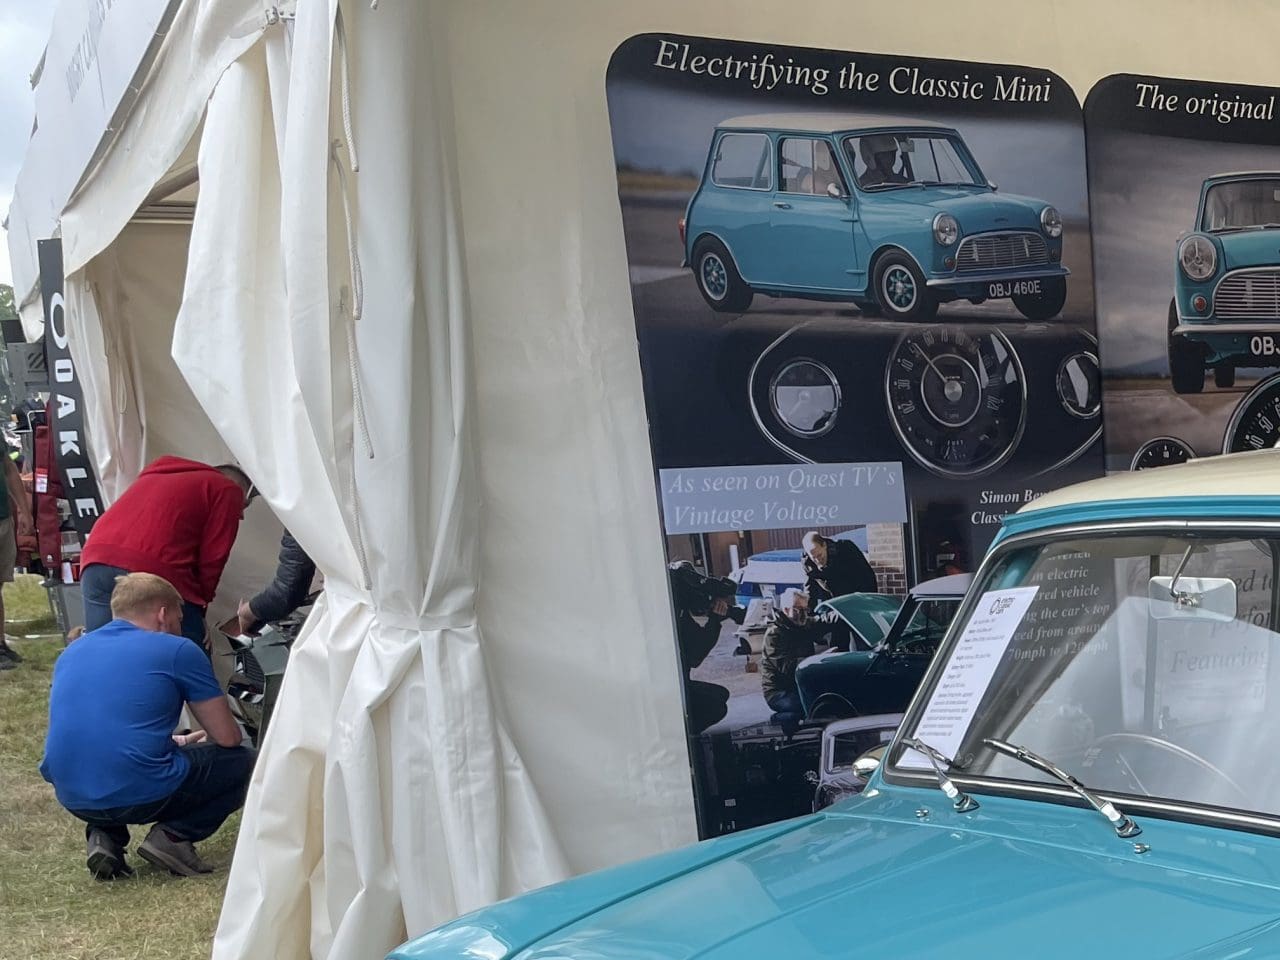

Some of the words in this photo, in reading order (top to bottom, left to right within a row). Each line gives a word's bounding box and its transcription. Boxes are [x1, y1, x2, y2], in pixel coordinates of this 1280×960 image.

[652, 39, 830, 94] Electrifying
[838, 61, 880, 92] the
[888, 66, 984, 100] Classic
[992, 75, 1053, 102] Mini
[1134, 83, 1178, 113] The
[1185, 92, 1274, 125] original
[1013, 279, 1042, 296] 460E
[1259, 416, 1274, 434] 50
[54, 359, 100, 540] OAKLE
[668, 473, 694, 494] As
[701, 475, 748, 492] seen
[755, 474, 780, 490] on
[787, 468, 846, 493] Quest
[851, 466, 896, 487] TV's
[980, 490, 1020, 504] Simon
[674, 503, 755, 528] Vintage
[763, 501, 839, 524] Voltage
[1047, 566, 1089, 582] electric
[1038, 588, 1058, 601] red
[1061, 584, 1100, 600] vehicle
[1023, 611, 1037, 623] ng
[1040, 605, 1058, 619] the
[1061, 604, 1091, 617] car's
[1092, 603, 1111, 617] top
[1013, 625, 1033, 640] eed
[1034, 624, 1064, 642] from
